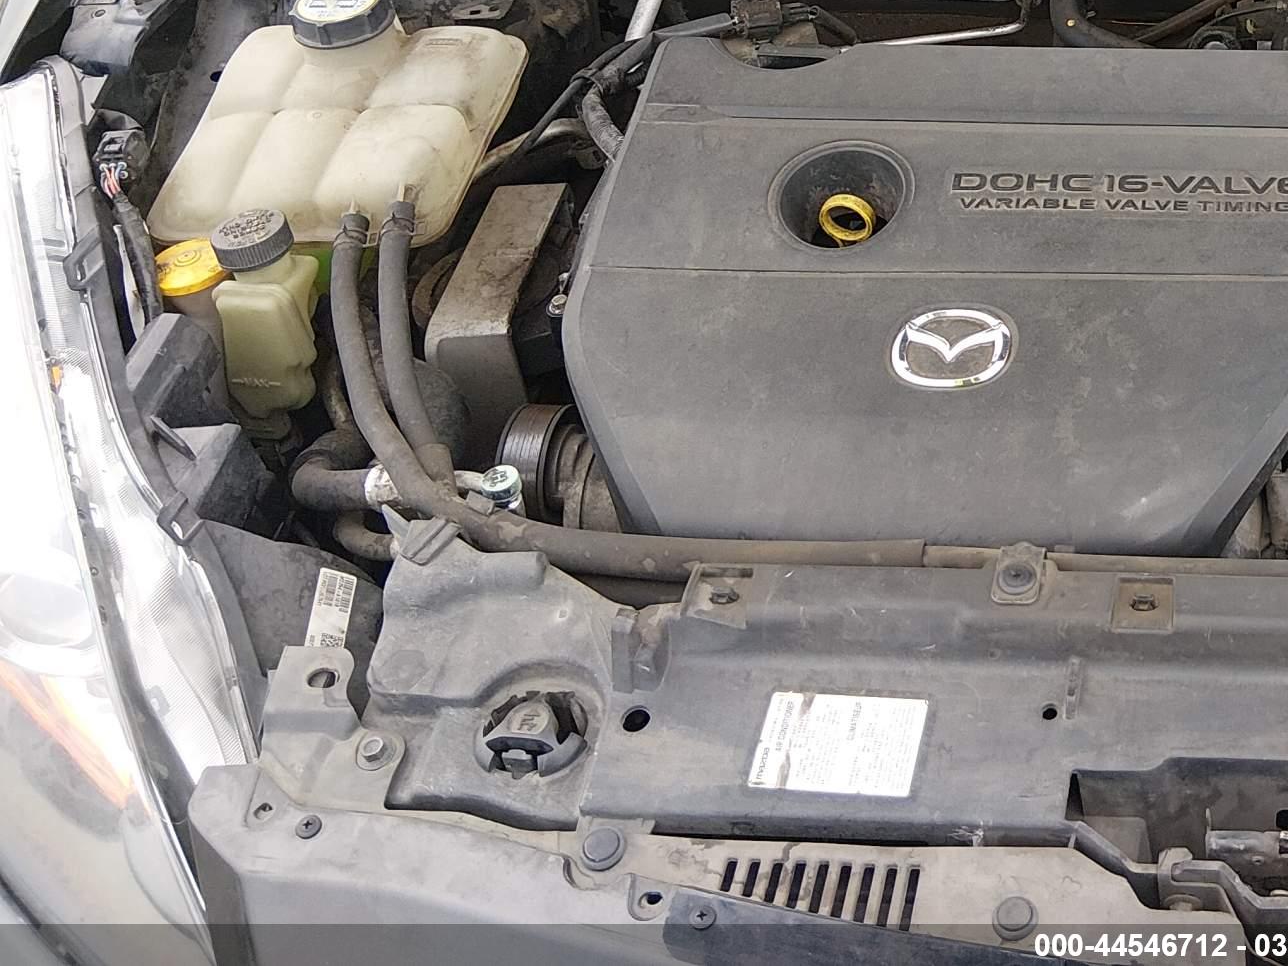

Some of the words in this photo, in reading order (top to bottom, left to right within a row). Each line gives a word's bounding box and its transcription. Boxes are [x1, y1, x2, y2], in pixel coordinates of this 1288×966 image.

[951, 172, 1094, 193] DOHC
[959, 197, 1096, 211] VARIABLE
[1105, 198, 1189, 212] VALVE
